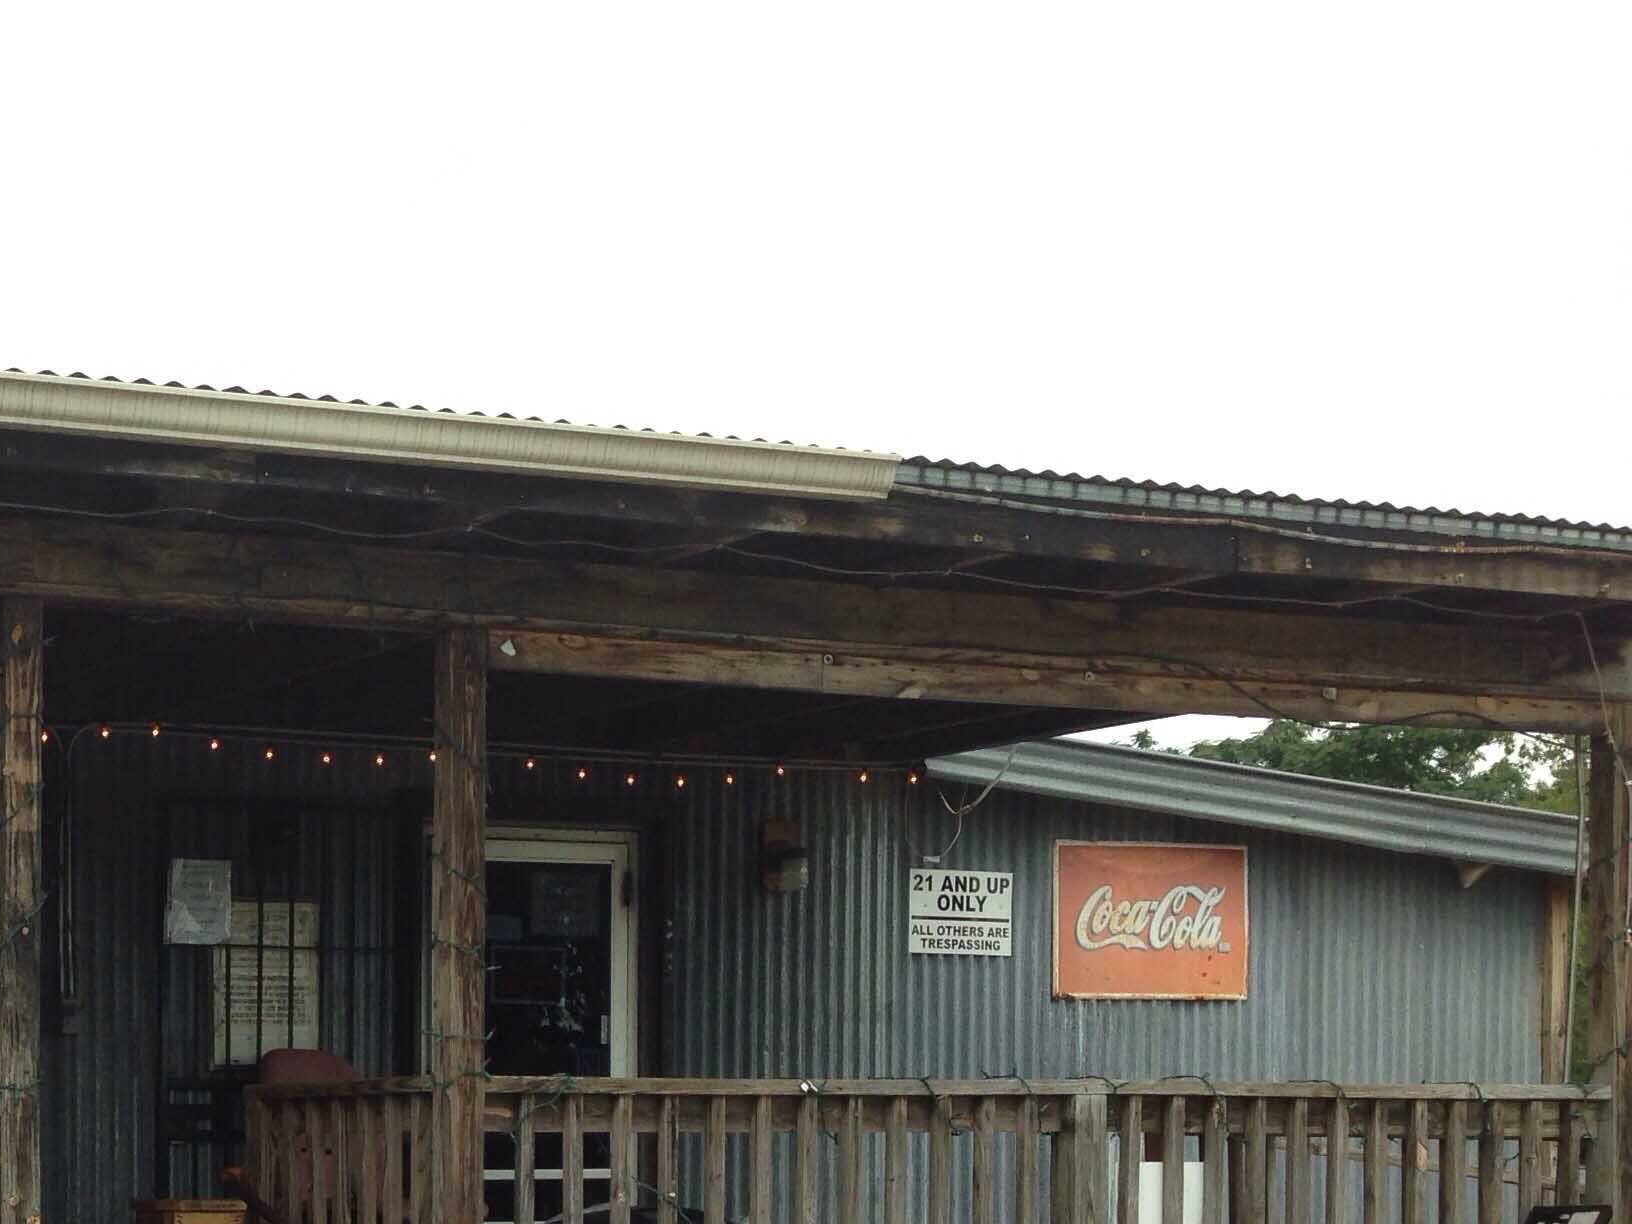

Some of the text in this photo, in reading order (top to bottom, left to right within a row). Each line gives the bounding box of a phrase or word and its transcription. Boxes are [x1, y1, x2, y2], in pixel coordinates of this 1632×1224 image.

[913, 874, 1010, 894] 21 AND UP
[937, 894, 987, 913] ONLY
[1076, 885, 1226, 952] Coca-Cola
[912, 925, 1009, 939] ALL OTHERS ARE
[920, 938, 1001, 951] TRESPASSING
